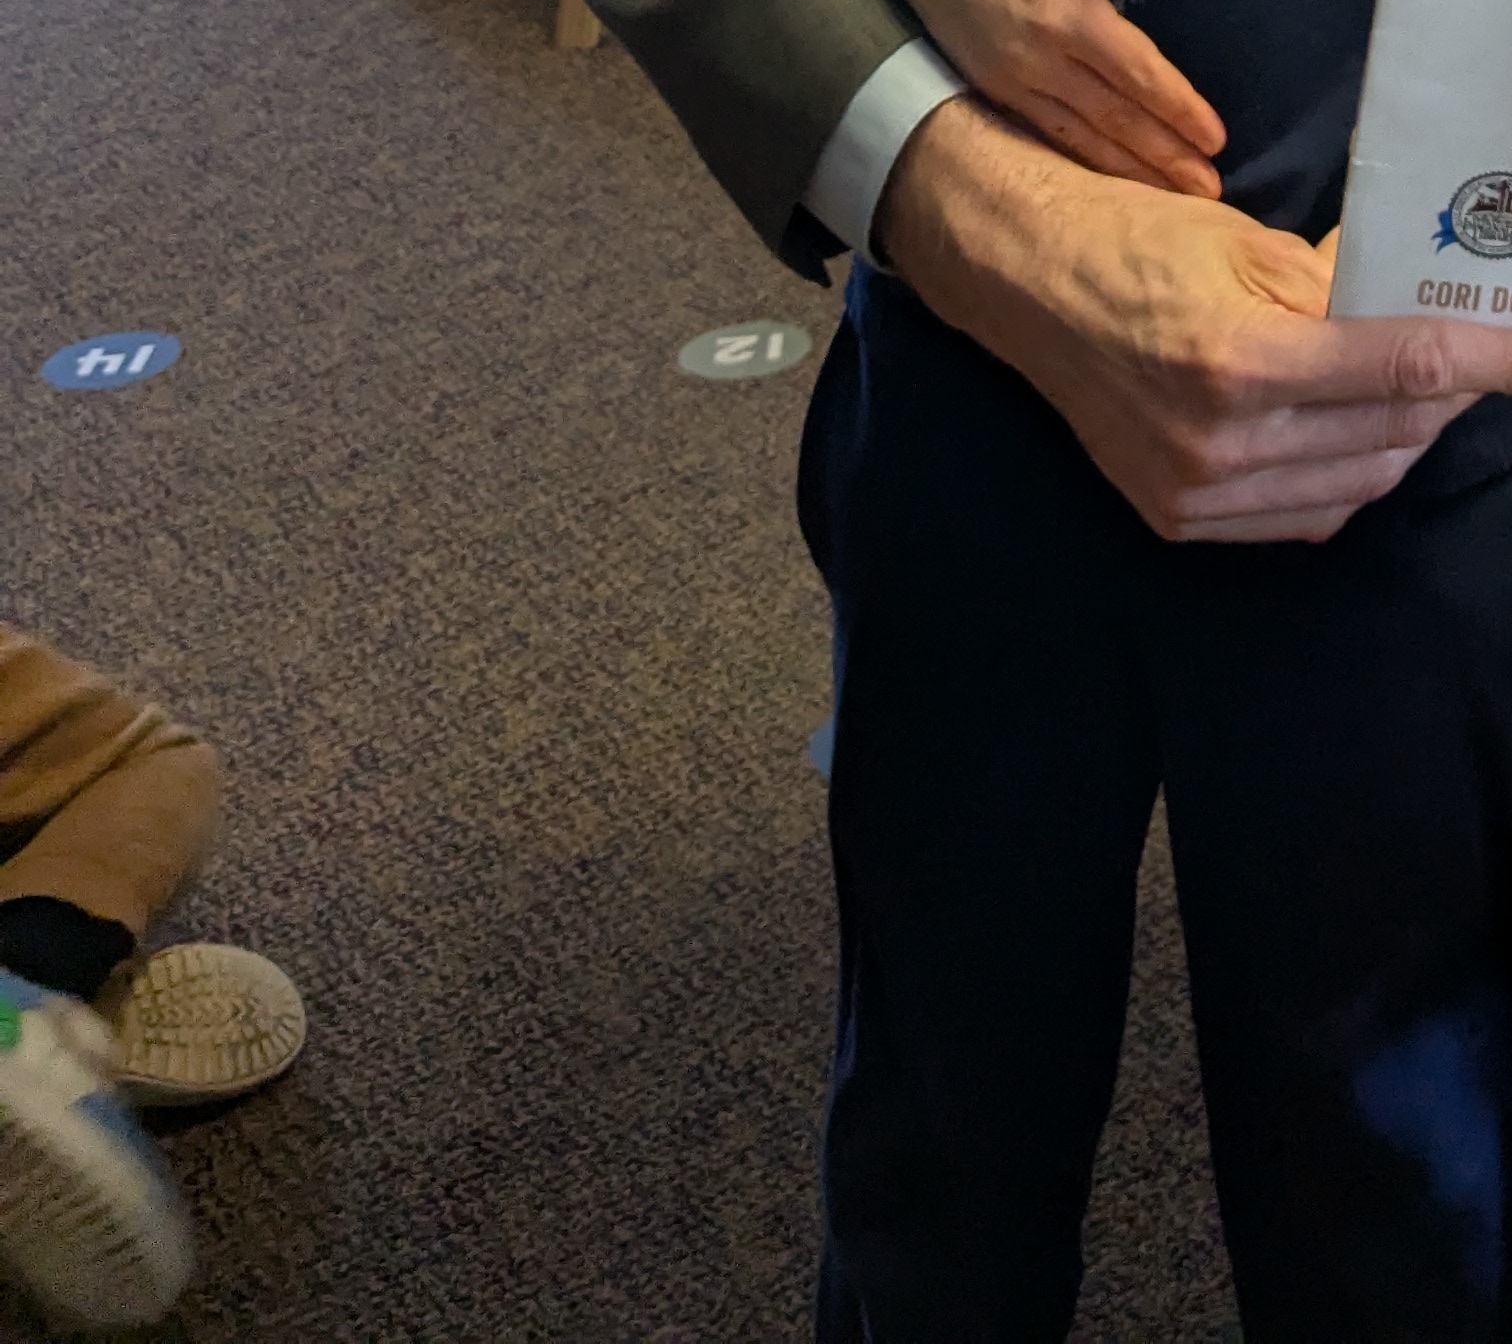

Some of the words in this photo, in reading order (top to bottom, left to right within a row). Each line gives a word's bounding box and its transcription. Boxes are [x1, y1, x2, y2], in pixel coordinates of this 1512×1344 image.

[1416, 278, 1483, 312] CORI
[76, 343, 157, 377] 14
[713, 332, 785, 365] 12
